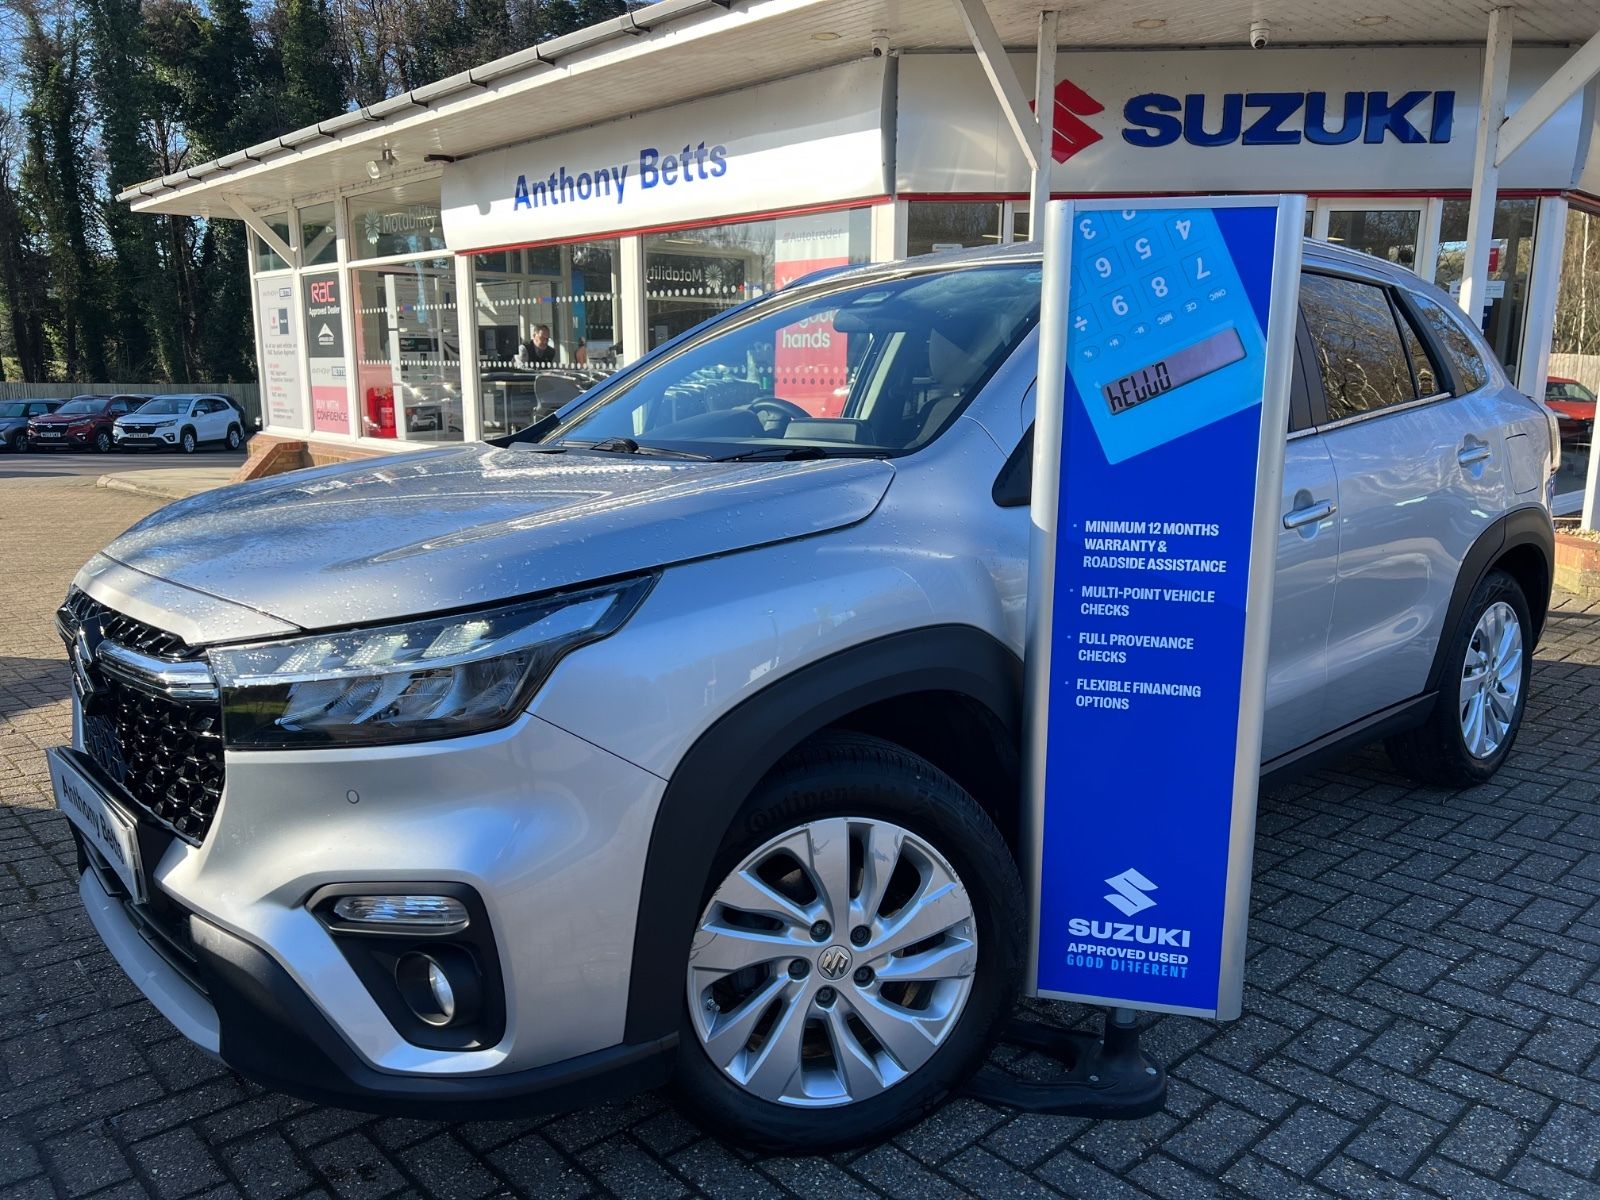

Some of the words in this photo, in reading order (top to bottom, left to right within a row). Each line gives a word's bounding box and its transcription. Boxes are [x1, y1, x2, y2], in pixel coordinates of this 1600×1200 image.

[1122, 90, 1456, 148] SUZUKI
[513, 163, 629, 212] Anthony
[638, 141, 728, 190] Betts
[383, 203, 438, 233] Motability
[790, 227, 842, 243] Autotrader
[1080, 219, 1096, 239] 3
[1175, 219, 1192, 240] 4
[1135, 237, 1152, 260] 5
[1196, 257, 1211, 280] 7
[311, 281, 336, 303] RAC
[1151, 276, 1168, 297] 8
[309, 306, 327, 317] Approved
[782, 328, 831, 348] hands
[316, 410, 348, 421] CONFIDENCE
[1085, 520, 1146, 534] MINIMUM
[1148, 522, 1161, 534] 12
[1163, 522, 1219, 537] MONTHS
[1084, 538, 1156, 552] WARRANTY
[1157, 540, 1167, 553] &
[1083, 556, 1145, 570] ROADSIDE
[1147, 557, 1227, 573] ASSISTANCE
[1081, 585, 1161, 601] MULTI-POINT
[1163, 588, 1215, 603] VEHICLE
[1080, 602, 1130, 617] CHECKS
[1079, 632, 1107, 646] FULL
[1109, 633, 1194, 650] PROVENANCE
[1078, 649, 1127, 664] CHECKS
[1076, 678, 1131, 693] FLEXIBLE
[1133, 681, 1202, 698] FINANCING
[1076, 695, 1130, 710] OPTIONS
[62, 775, 100, 838] Anthony
[99, 812, 125, 865] Betts
[1068, 918, 1191, 948] SUZUKI
[1067, 942, 1146, 960] APPROVED
[1148, 951, 1189, 965] USED
[1066, 954, 1104, 969] GOOD
[1111, 959, 1188, 979] DIFFERENT
